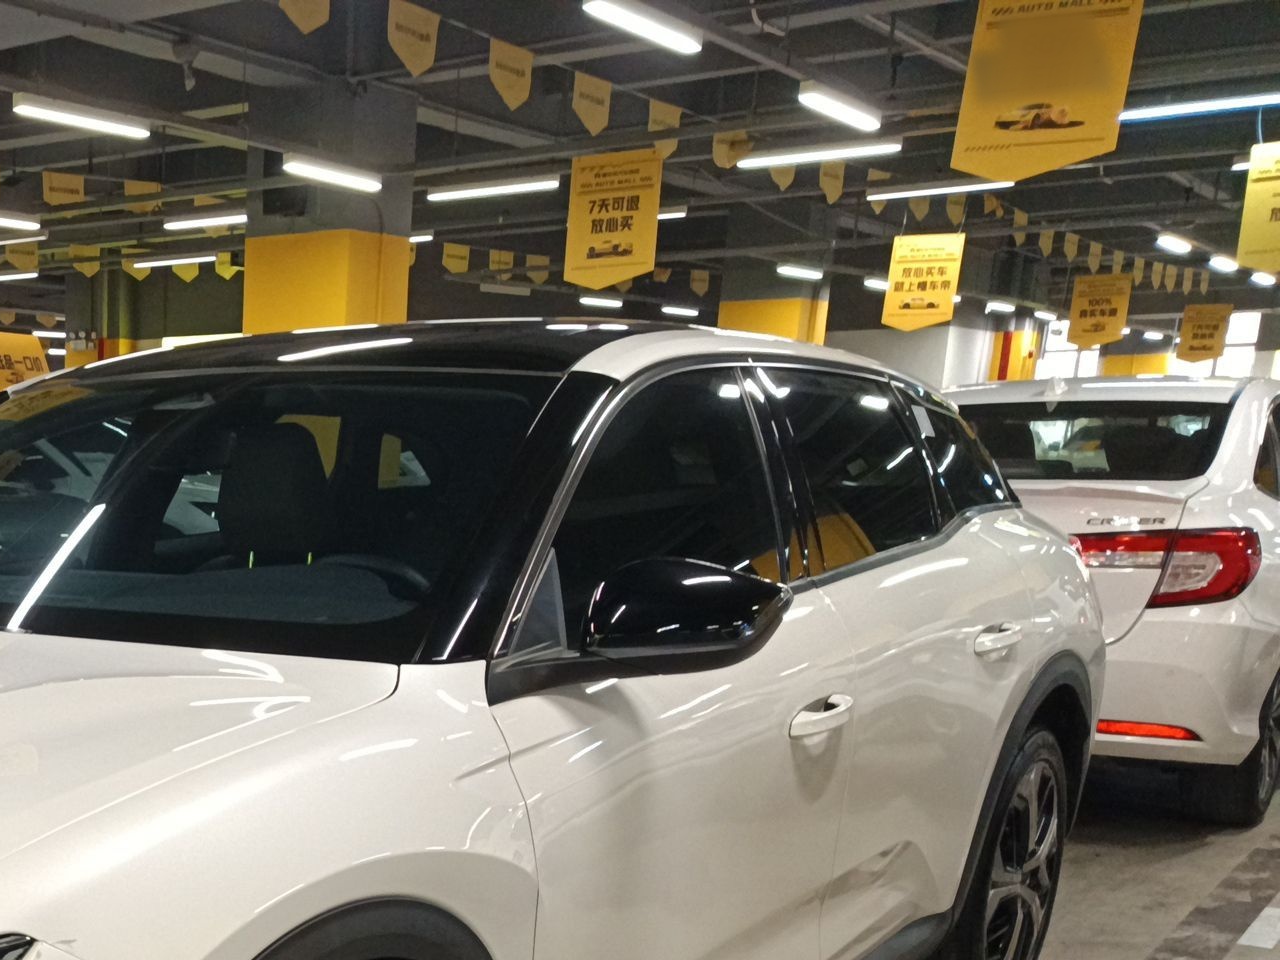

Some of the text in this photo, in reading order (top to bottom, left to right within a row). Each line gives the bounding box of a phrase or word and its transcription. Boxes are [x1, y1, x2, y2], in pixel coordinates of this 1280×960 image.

[1018, 2, 1054, 13] AUTO
[589, 195, 640, 214] 7天可退
[591, 216, 634, 234] 放心买
